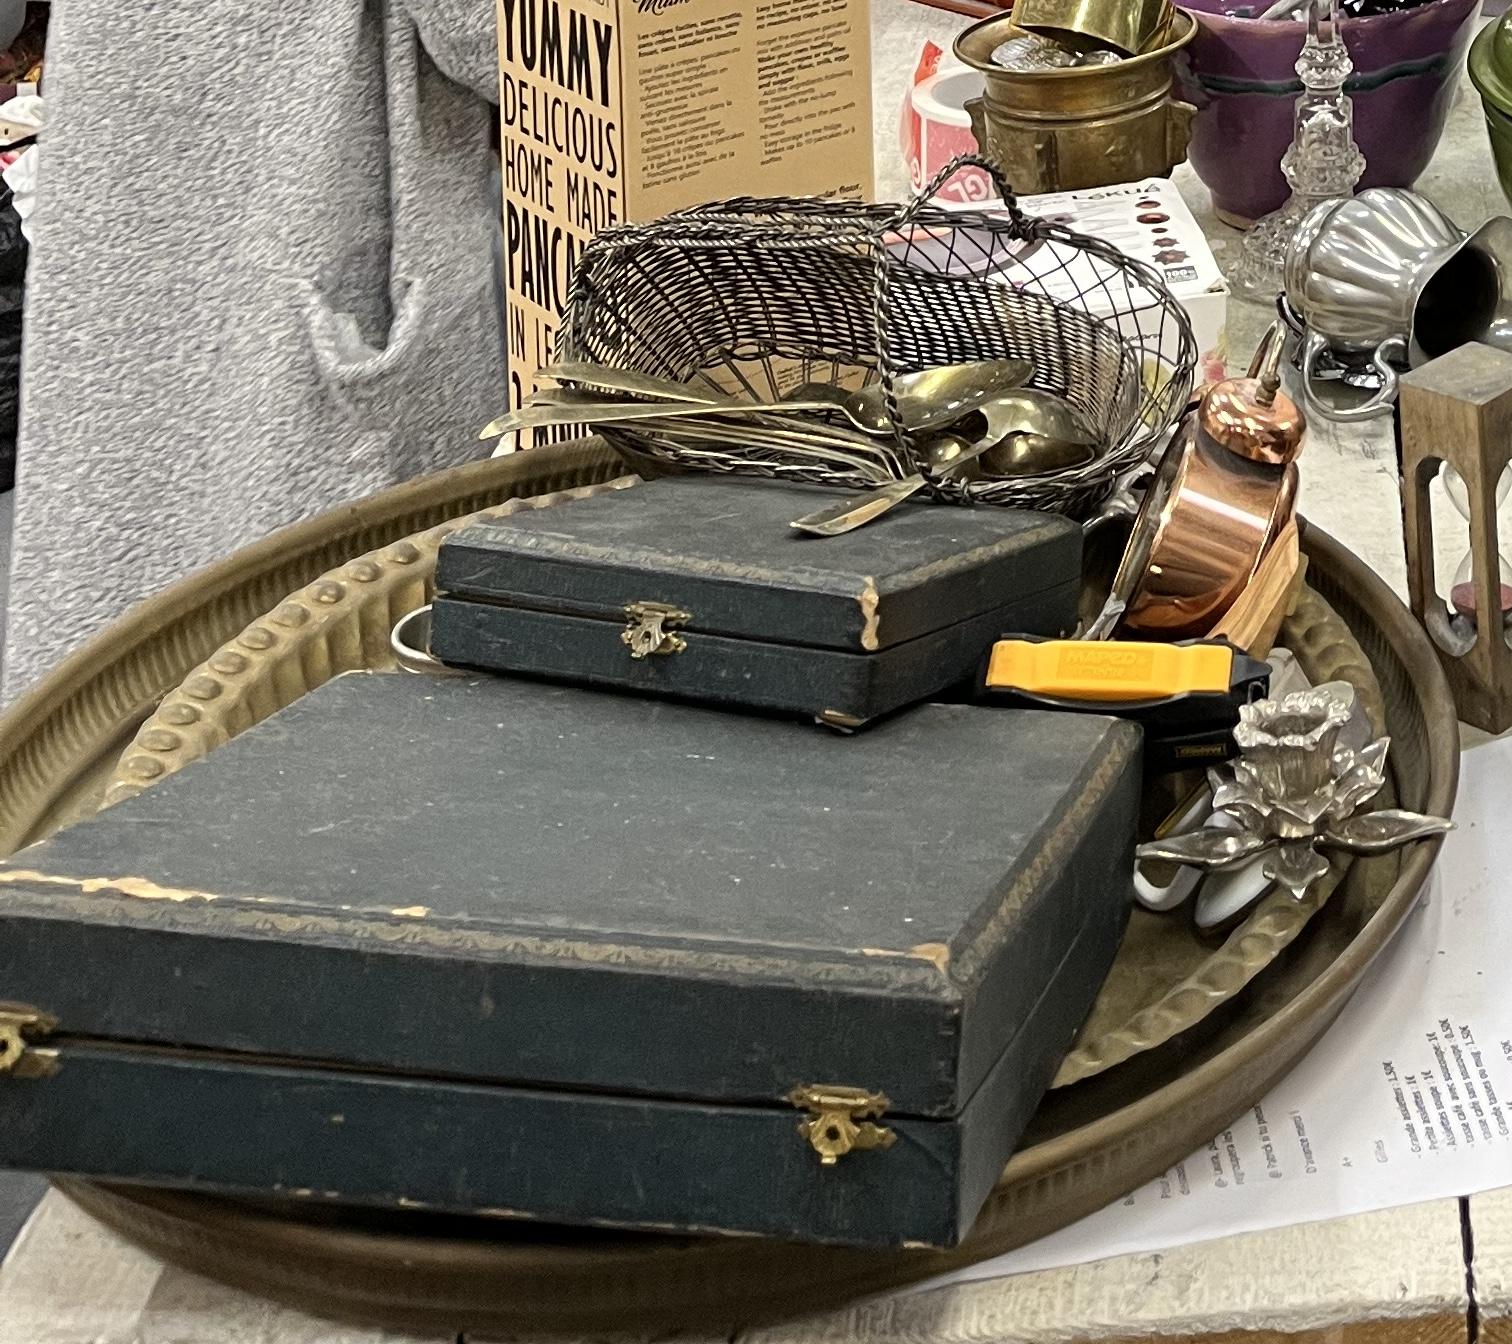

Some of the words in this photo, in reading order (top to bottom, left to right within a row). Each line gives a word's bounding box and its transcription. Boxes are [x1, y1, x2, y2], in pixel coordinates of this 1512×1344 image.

[503, 71, 618, 179] DELICIOUS
[504, 135, 555, 214] HOME
[567, 167, 618, 235] MADE
[948, 172, 990, 202] GL
[510, 301, 526, 363] IN
[1404, 1122, 1422, 1153] Grande
